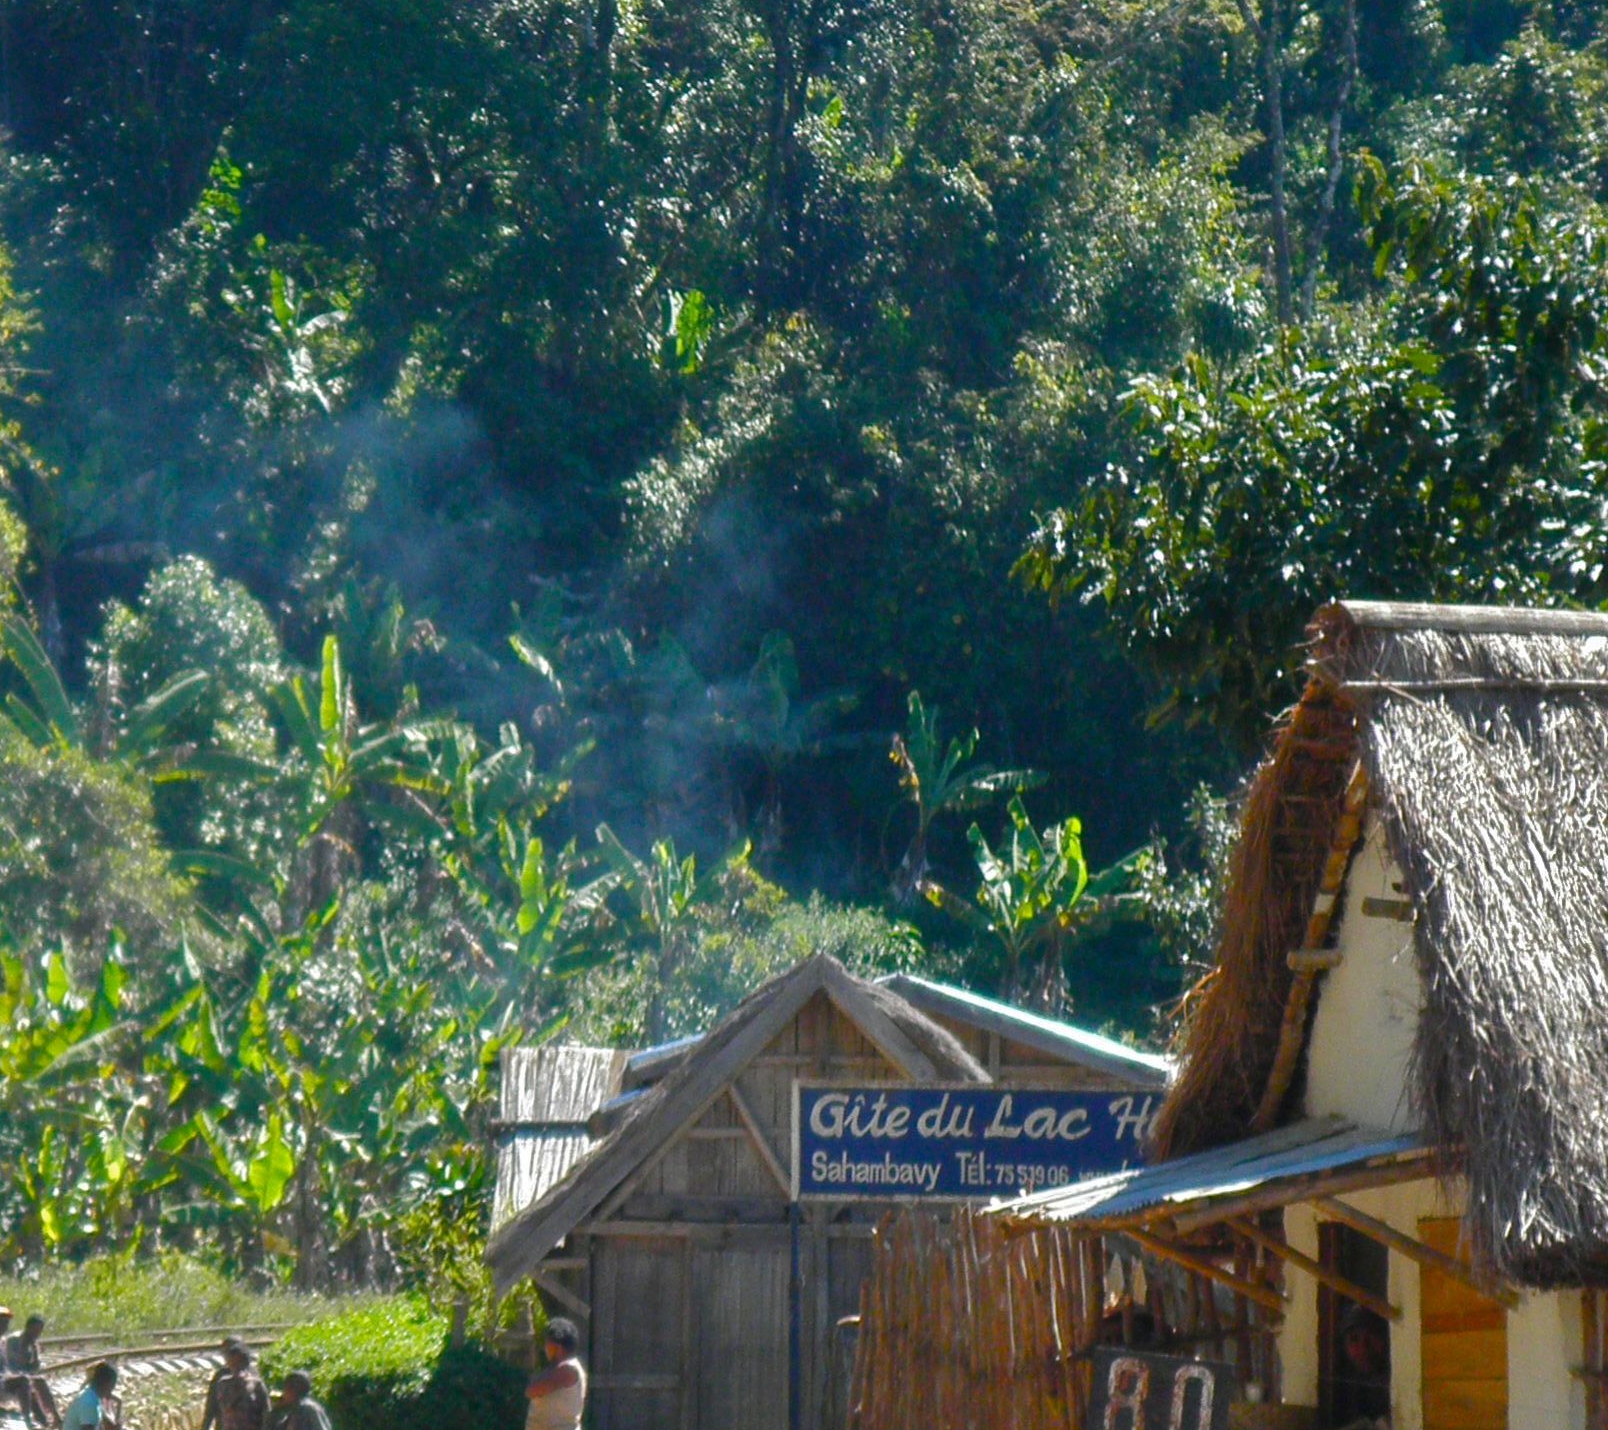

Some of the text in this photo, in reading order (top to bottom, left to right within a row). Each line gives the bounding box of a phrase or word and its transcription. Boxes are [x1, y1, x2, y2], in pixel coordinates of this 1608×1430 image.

[810, 1092, 910, 1139] Gîte
[917, 1092, 975, 1139] du
[984, 1093, 1091, 1140] Lac
[811, 1150, 941, 1192] Sahambavy
[955, 1150, 992, 1185] Tél:
